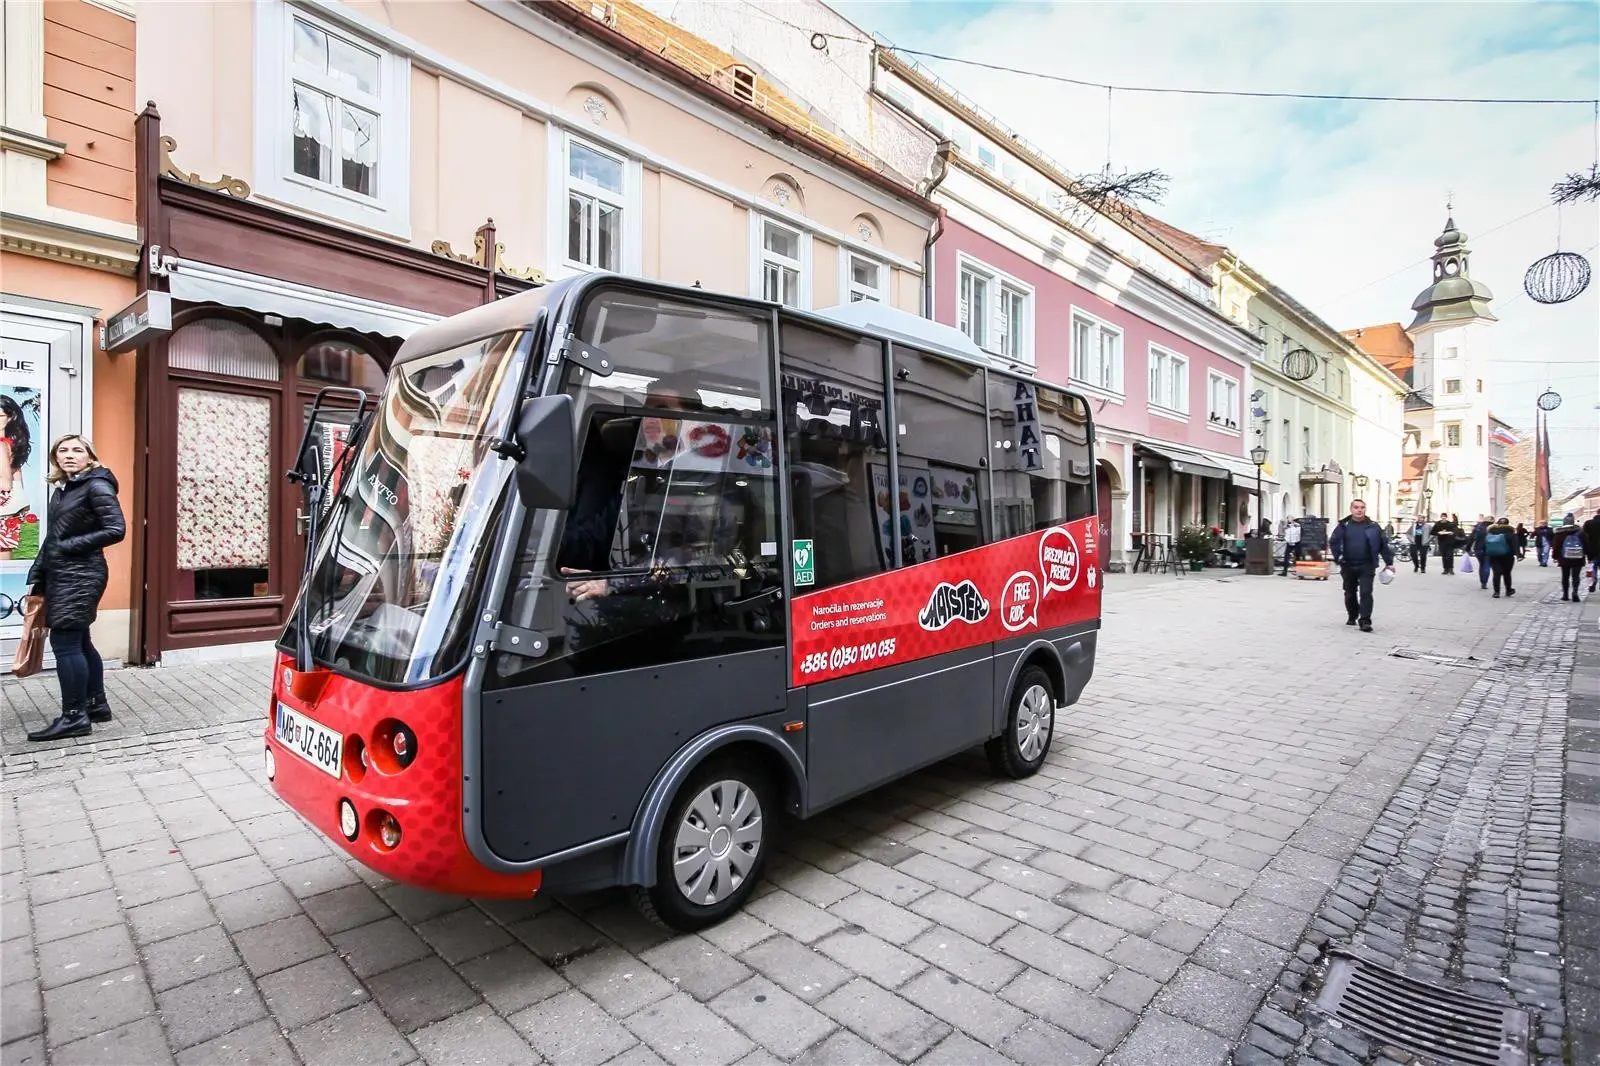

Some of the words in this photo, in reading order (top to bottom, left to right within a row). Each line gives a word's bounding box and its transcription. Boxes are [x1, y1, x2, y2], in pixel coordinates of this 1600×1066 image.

[0, 358, 34, 372] UE
[796, 571, 813, 582] AED
[1050, 563, 1071, 581] PREVOZ
[1013, 581, 1031, 602] FREE
[812, 604, 842, 617] Naročila
[842, 602, 850, 612] in
[850, 598, 884, 612] rezervacije
[921, 583, 988, 628] MAISTER
[1009, 603, 1026, 623] RIDE
[810, 620, 835, 631] Orders
[835, 616, 849, 627] and
[849, 611, 887, 625] reservations
[800, 651, 828, 674] +386
[829, 645, 858, 671] (0)30
[859, 642, 877, 662] 100
[877, 637, 896, 658] 035
[281, 711, 295, 744] MB
